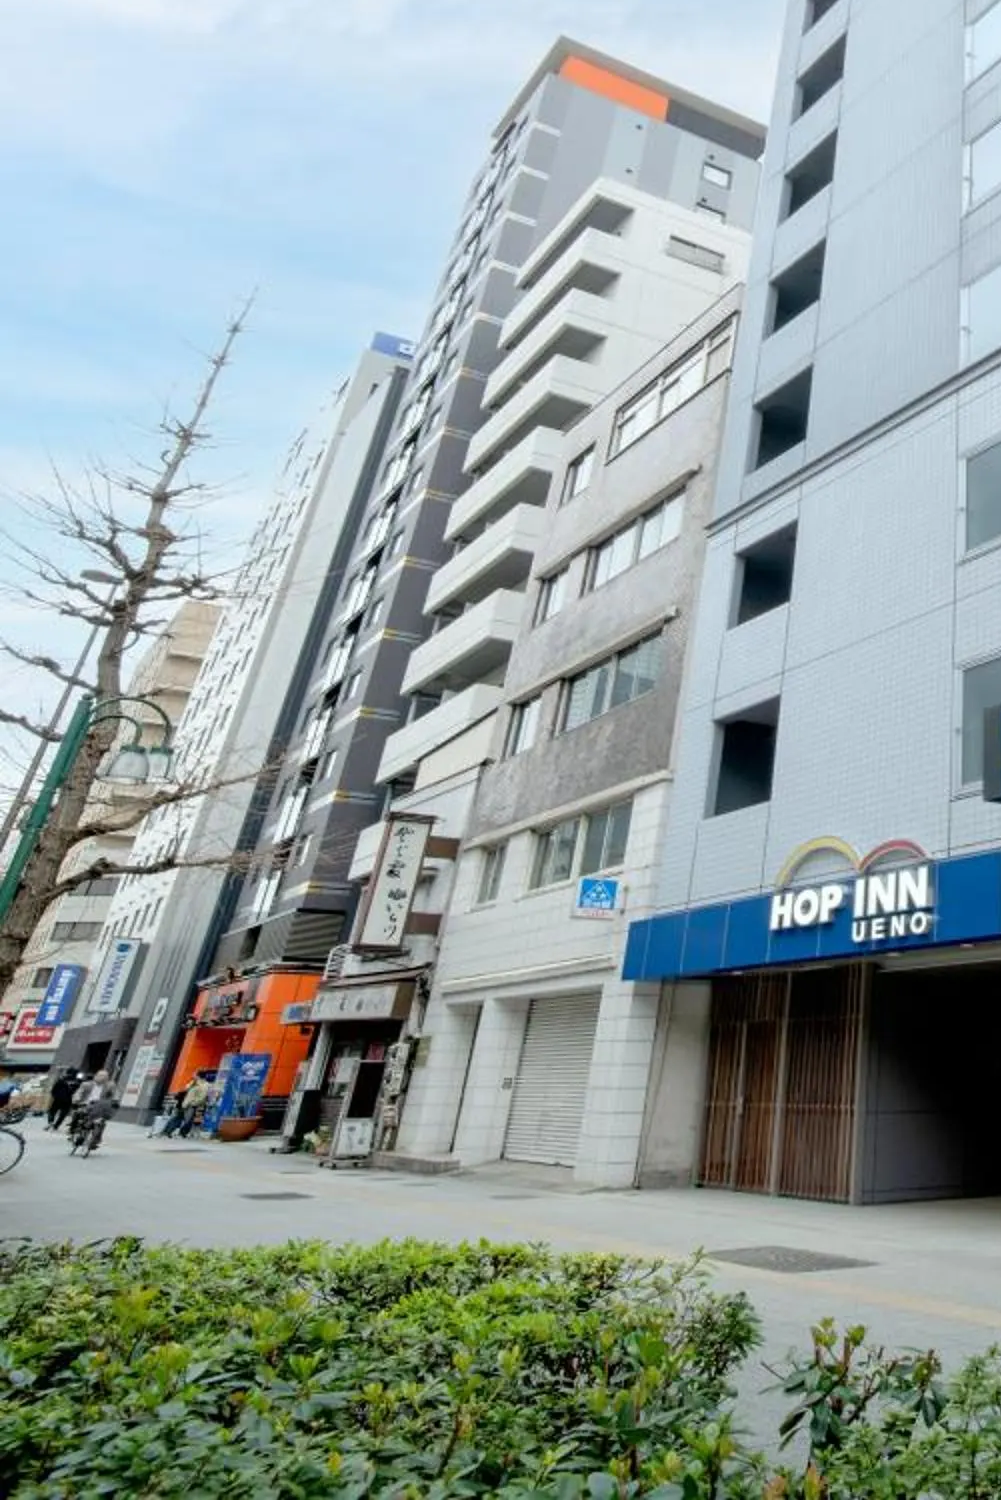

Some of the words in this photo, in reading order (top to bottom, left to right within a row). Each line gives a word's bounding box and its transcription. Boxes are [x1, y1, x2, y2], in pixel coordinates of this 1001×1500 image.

[770, 884, 843, 931] HOP
[853, 866, 929, 918] INN
[852, 911, 928, 943] UENO
